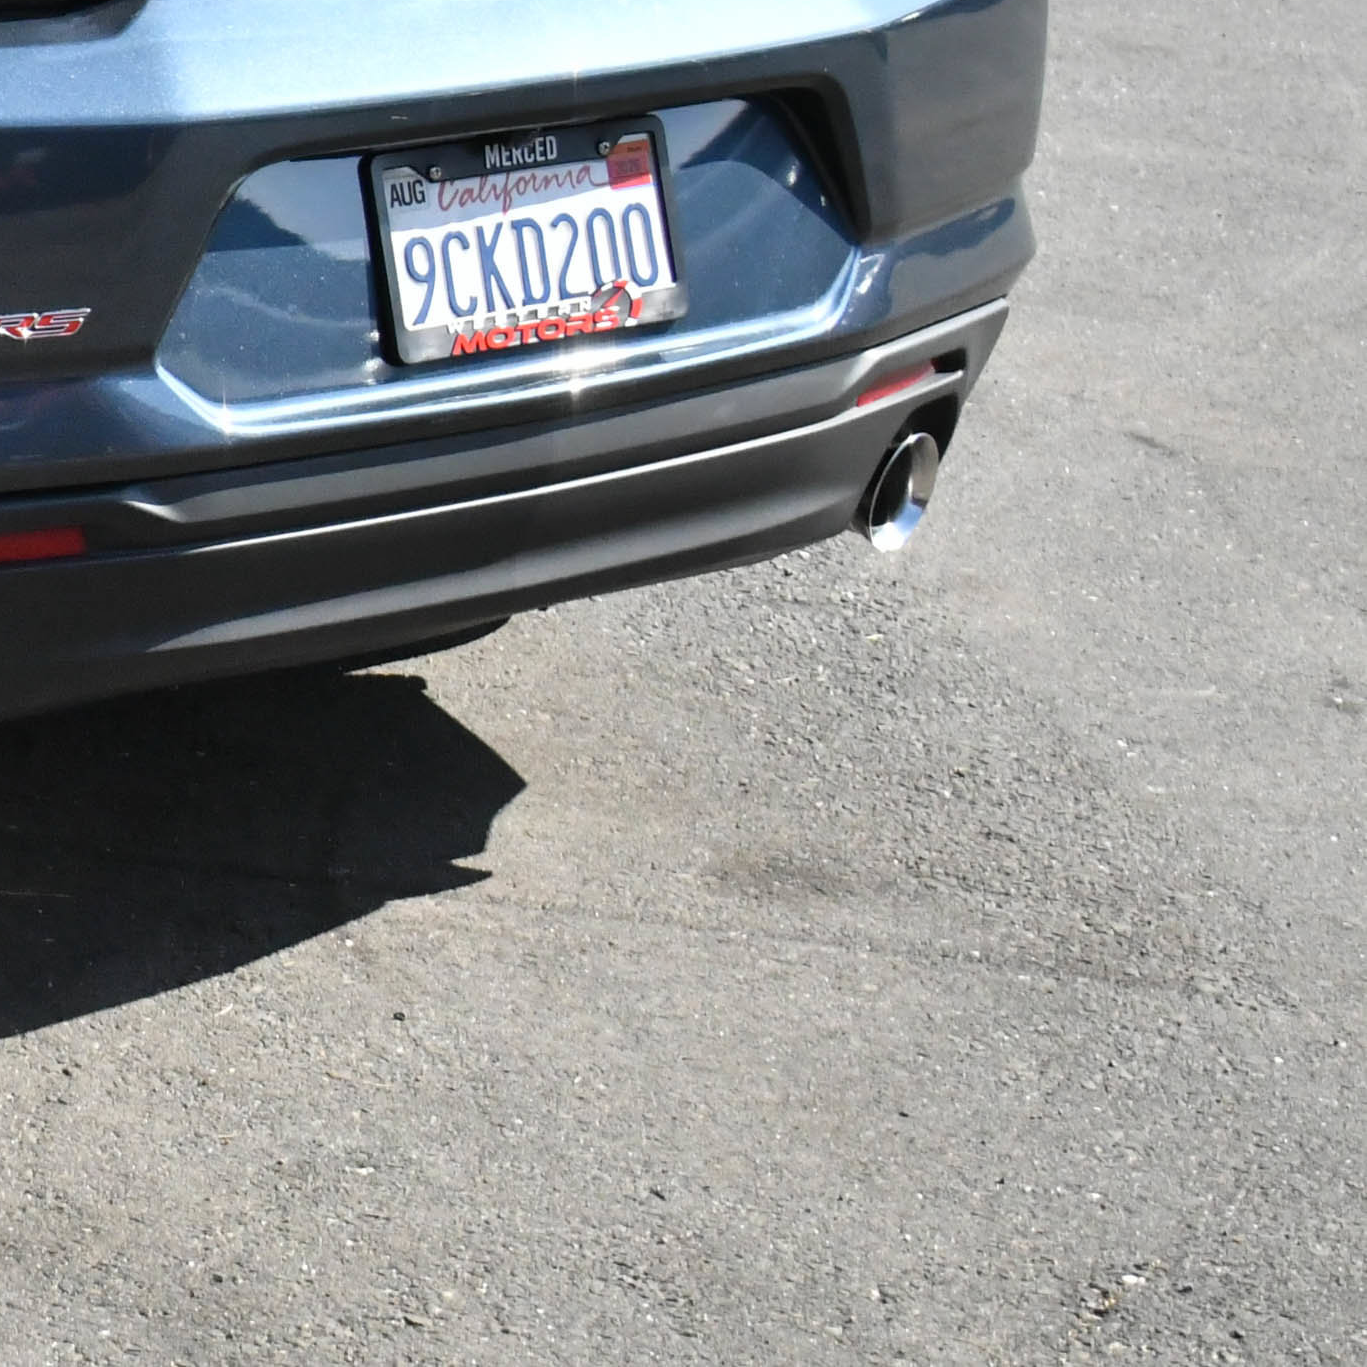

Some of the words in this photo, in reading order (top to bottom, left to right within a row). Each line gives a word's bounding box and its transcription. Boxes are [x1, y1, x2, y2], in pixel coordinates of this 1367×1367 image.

[484, 135, 558, 169] MERCED
[390, 179, 426, 208] AUG
[437, 164, 609, 215] California
[403, 202, 659, 326] 9CKD200
[452, 307, 620, 356] MOTORS
